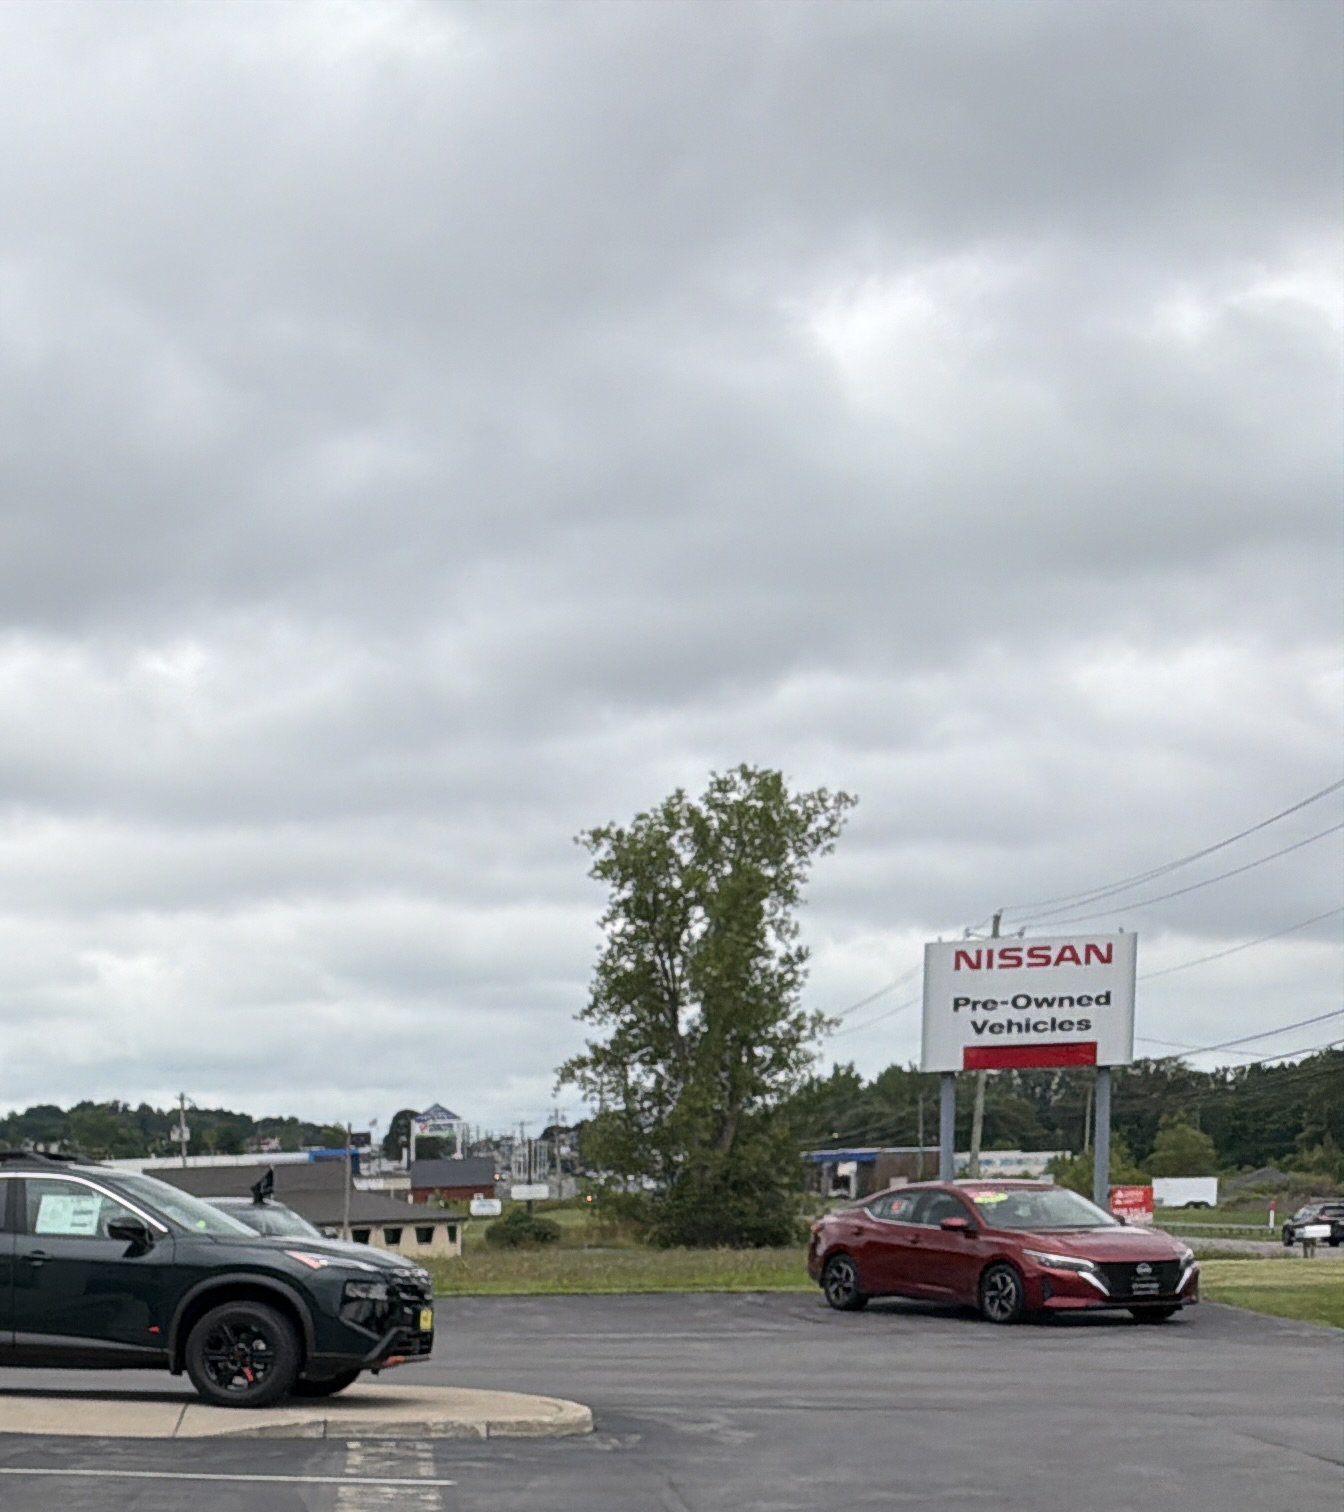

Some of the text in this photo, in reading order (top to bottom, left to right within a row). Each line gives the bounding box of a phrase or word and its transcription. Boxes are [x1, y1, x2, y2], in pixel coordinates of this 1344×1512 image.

[954, 942, 1113, 971] NISSAN
[953, 990, 1111, 1012] Pre-Owned
[971, 1017, 1092, 1035] Vehicles
